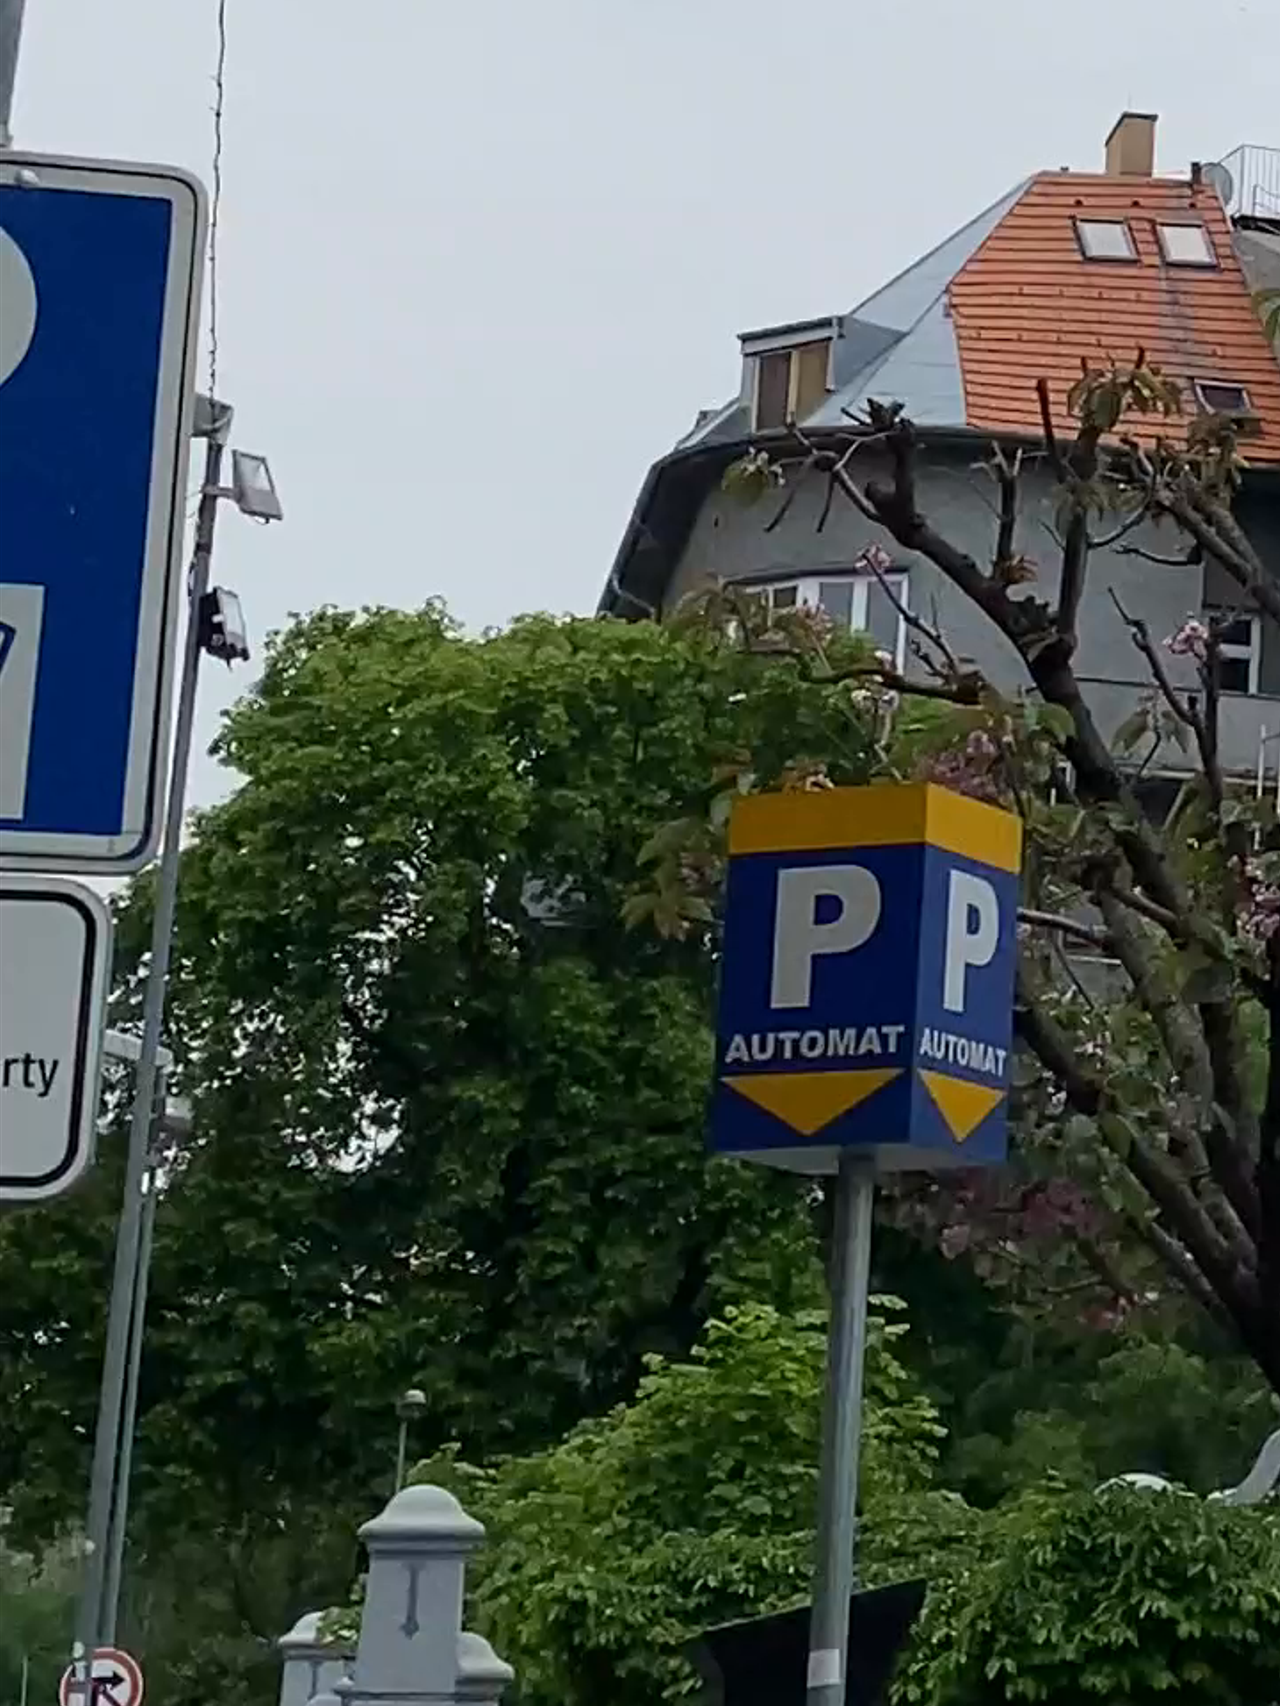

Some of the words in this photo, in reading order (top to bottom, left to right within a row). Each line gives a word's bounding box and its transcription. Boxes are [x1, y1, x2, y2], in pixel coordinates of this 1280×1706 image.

[770, 864, 882, 1010] P
[943, 869, 1000, 1013] P
[725, 1023, 906, 1065] AUTOMAT
[919, 1026, 1009, 1078] AUTOMAT
